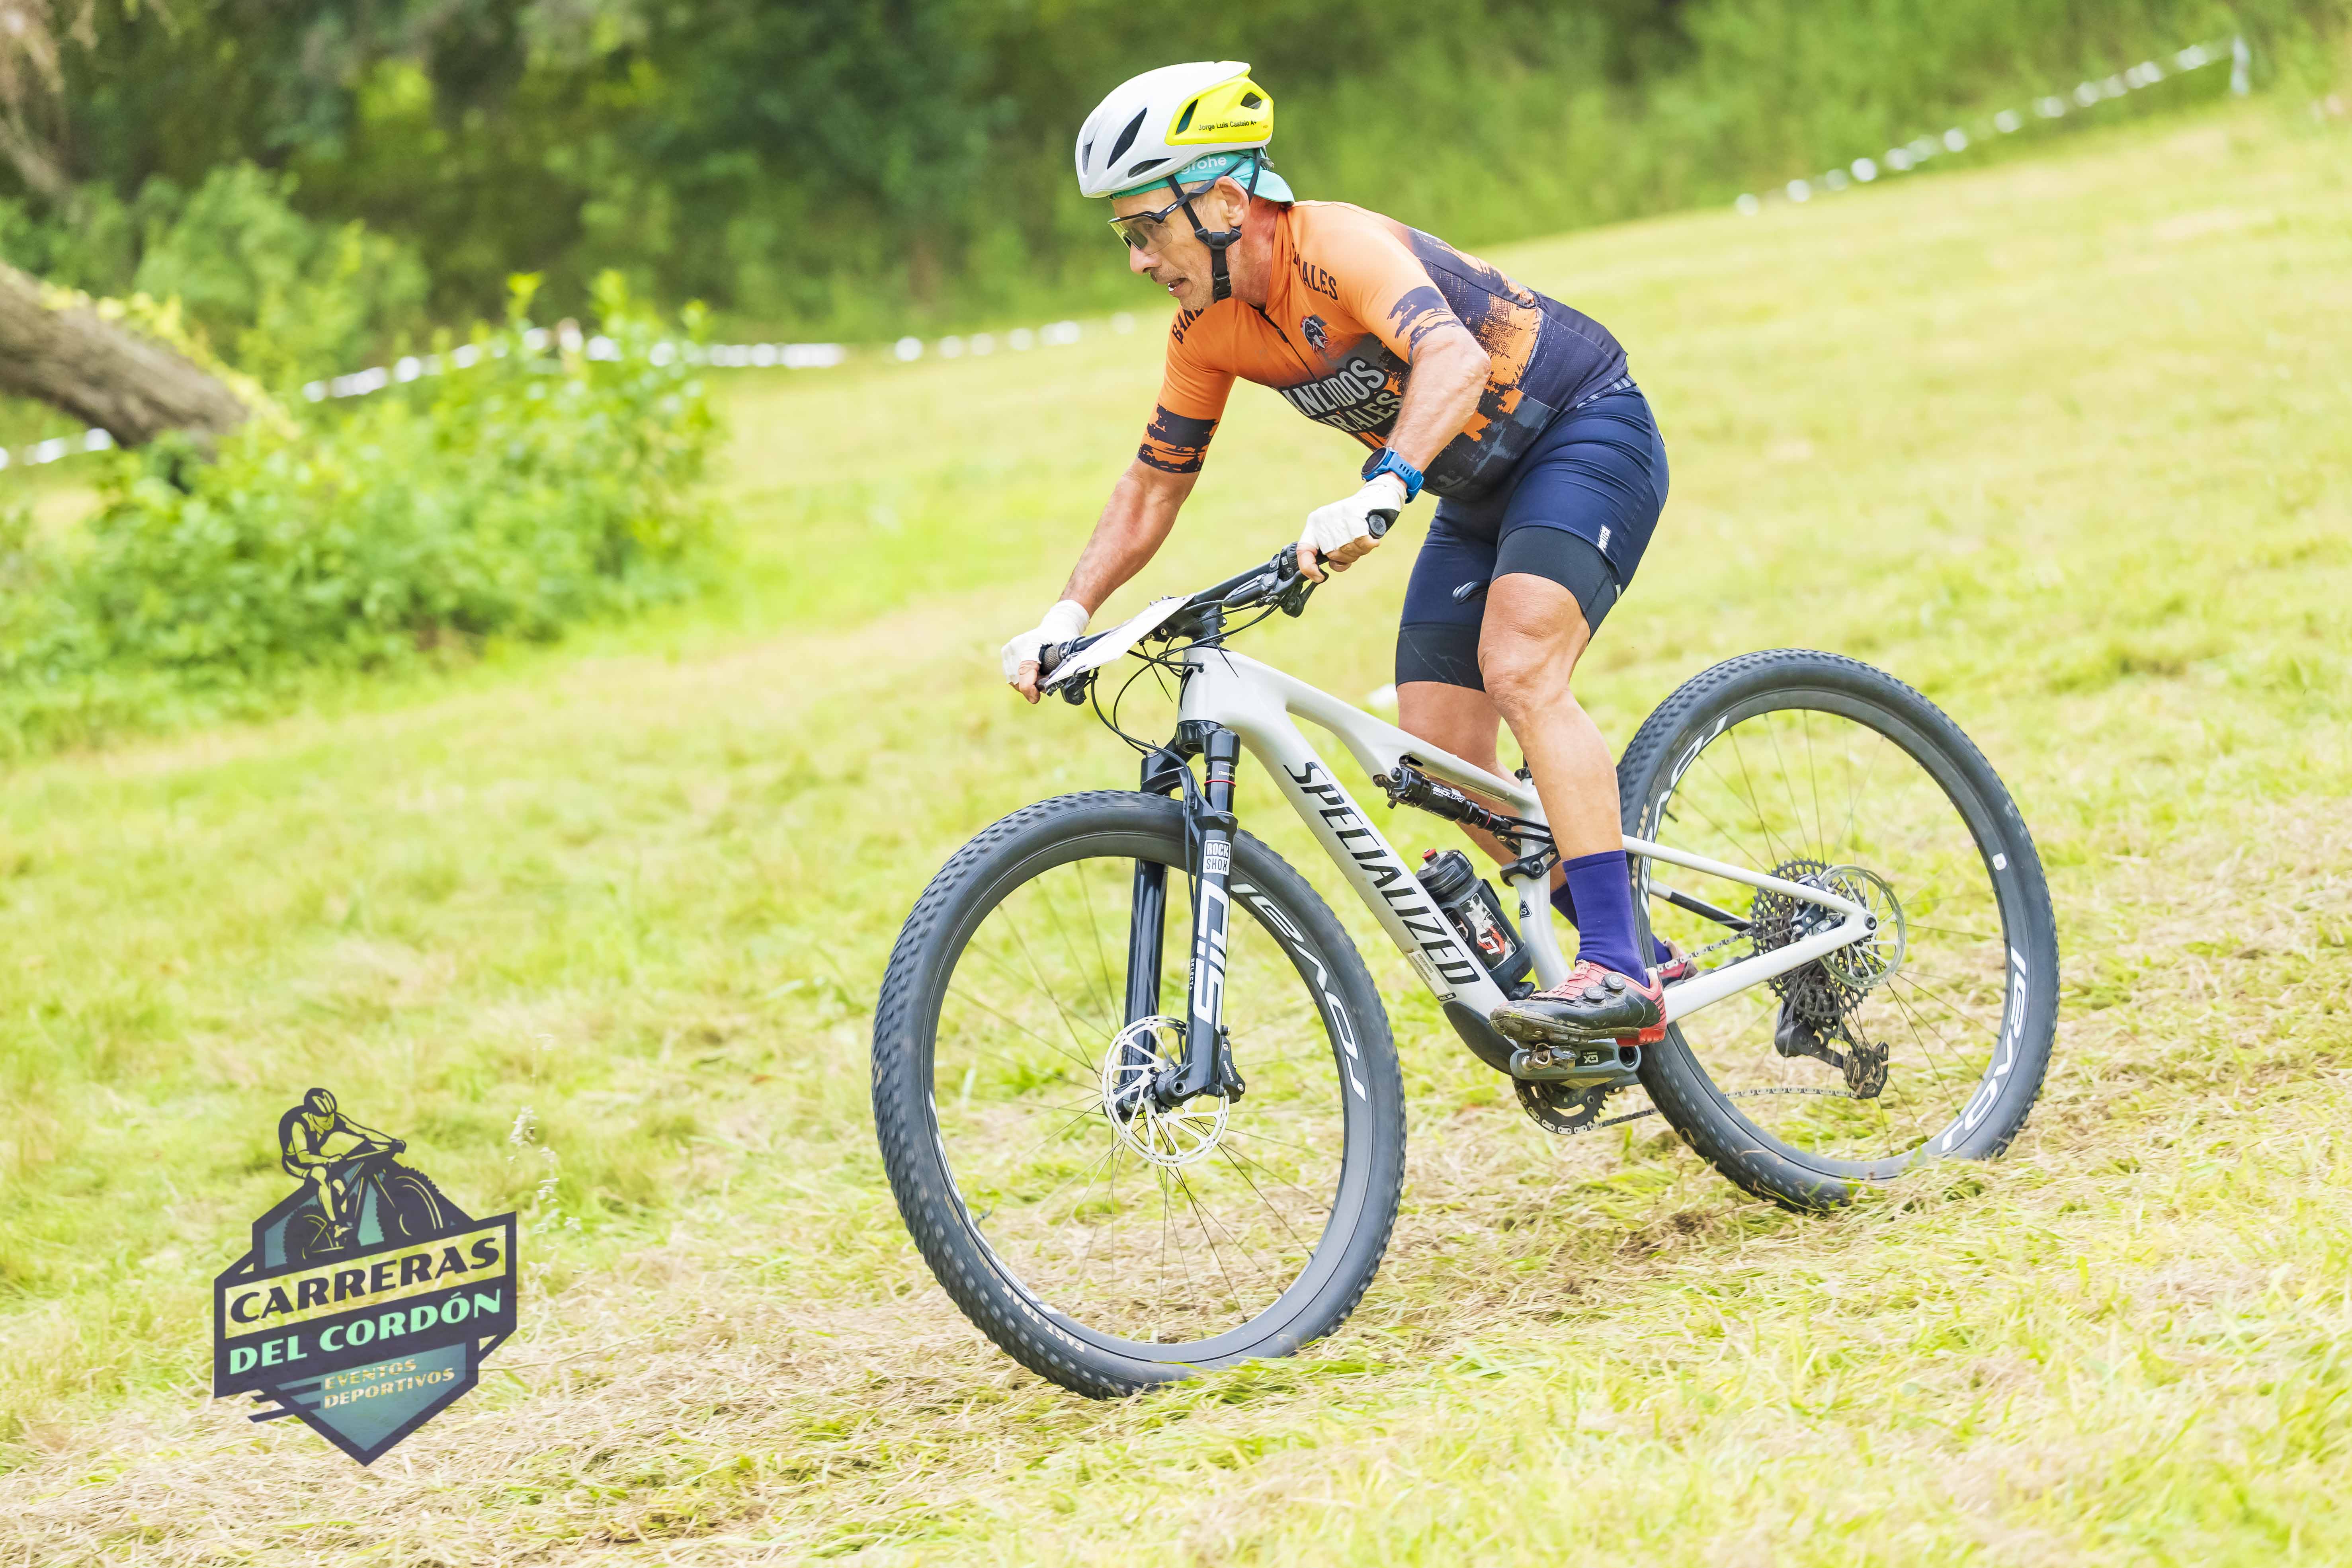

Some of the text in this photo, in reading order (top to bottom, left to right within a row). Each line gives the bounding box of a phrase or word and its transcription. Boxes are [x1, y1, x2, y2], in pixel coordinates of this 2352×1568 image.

[1206, 843, 1229, 857] ROCK
[1206, 858, 1227, 872] SHOX
[1282, 762, 1481, 984] SPECIALIZED
[1584, 1055, 1599, 1064] GX
